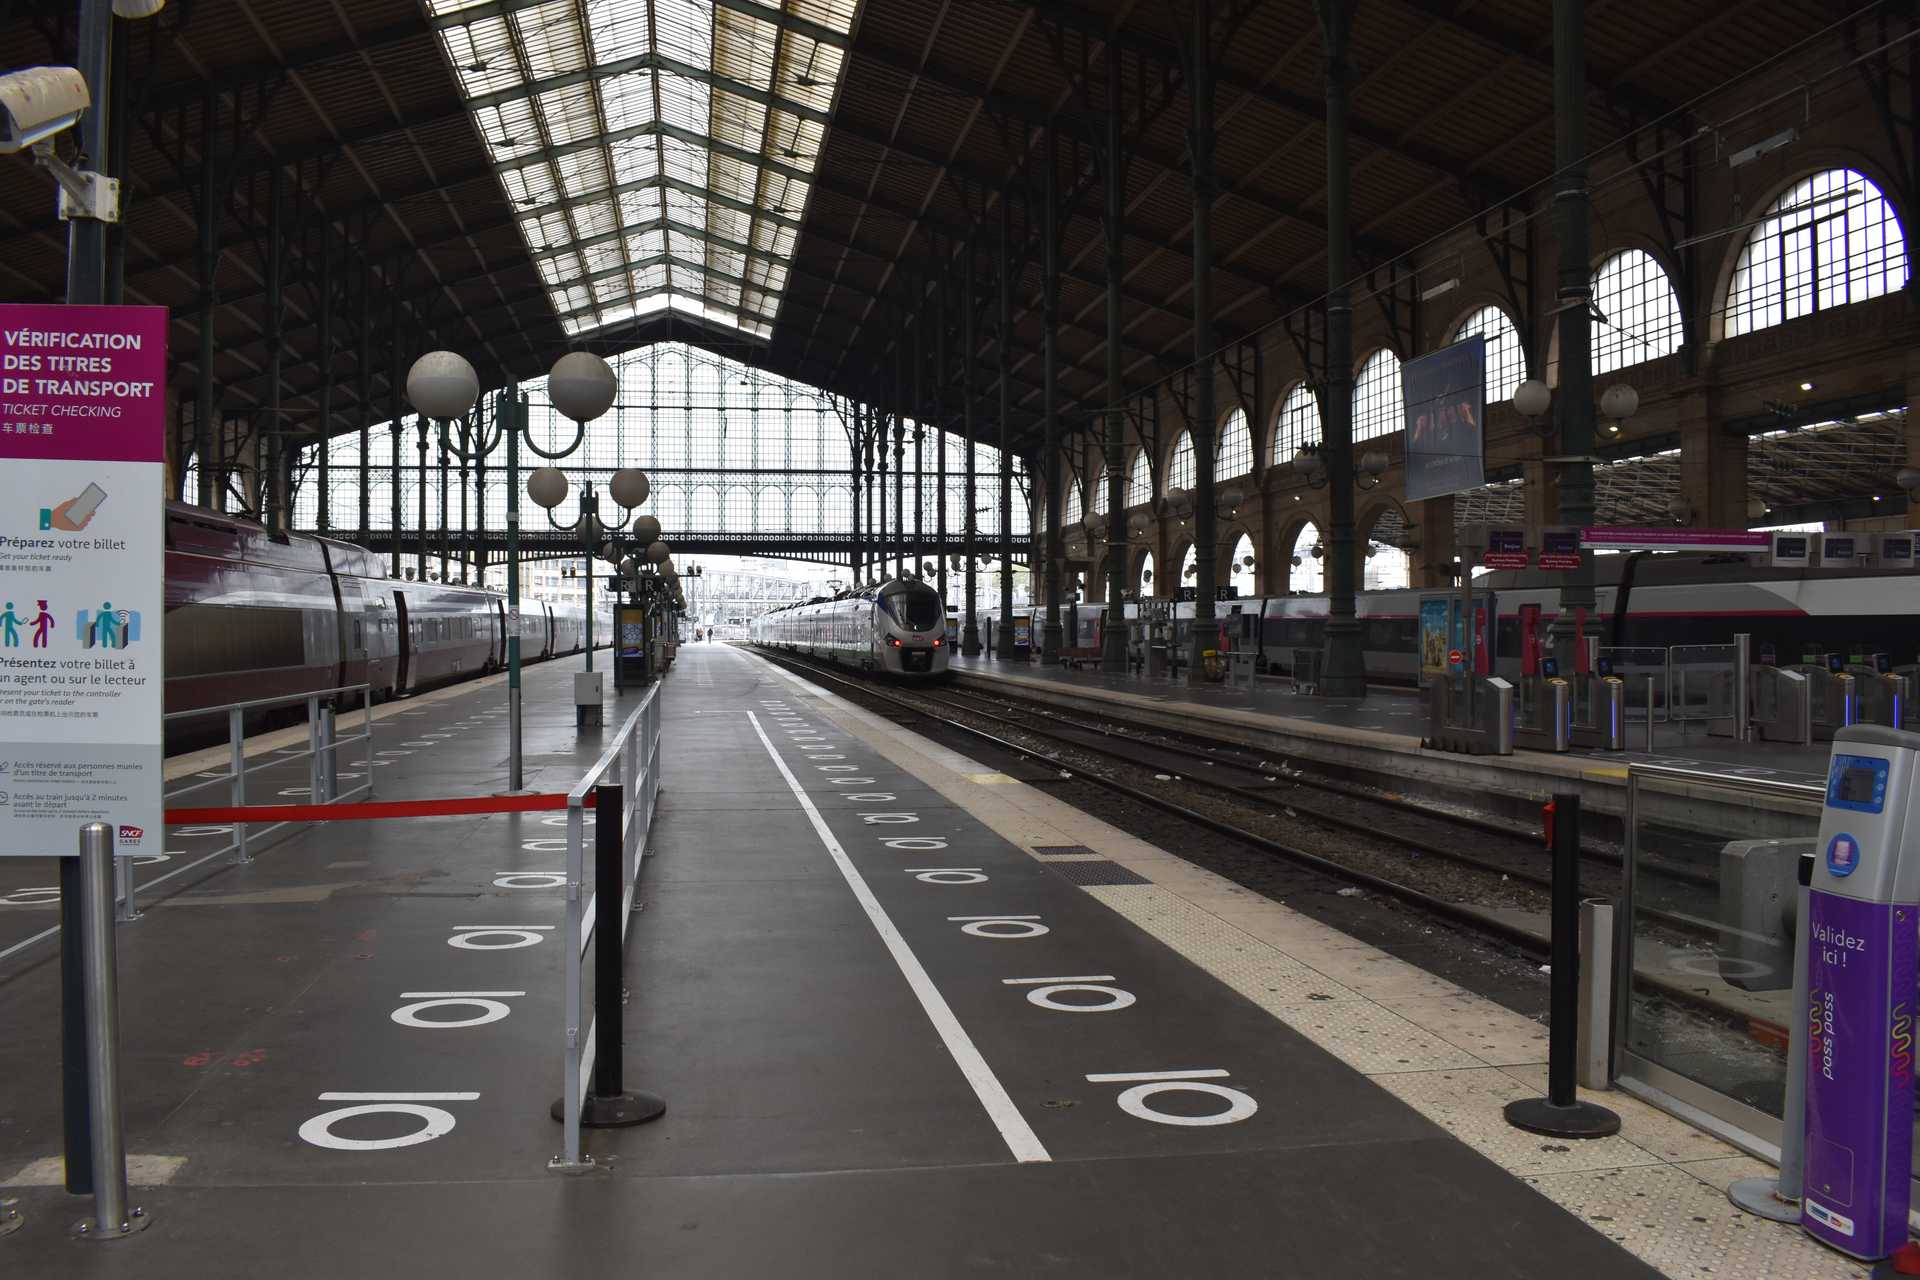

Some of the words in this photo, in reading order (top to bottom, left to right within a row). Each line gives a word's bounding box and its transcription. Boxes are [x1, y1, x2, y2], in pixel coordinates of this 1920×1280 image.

[4, 328, 141, 350] VÉRIFICATION
[4, 355, 41, 371] DES
[48, 356, 112, 373] TITRES
[3, 379, 29, 394] DE
[36, 380, 154, 398] TRANSPORT
[3, 403, 48, 416] TICKET
[51, 404, 122, 418] CHECKING
[0, 536, 55, 549] Préparez
[58, 540, 90, 549] votre
[94, 538, 126, 550] billet
[645, 579, 654, 591] R
[1184, 590, 1191, 600] R
[1220, 590, 1228, 600] R
[60, 660, 91, 669] votre
[94, 658, 125, 670] billet
[128, 659, 135, 670] à
[14, 674, 47, 686] agent
[50, 676, 65, 684] ou
[69, 676, 87, 684] sur
[90, 674, 101, 684] le
[104, 674, 146, 685] lecteur
[14, 761, 34, 769] Accès
[1812, 920, 1865, 952] Validez
[1823, 947, 1838, 966] ici
